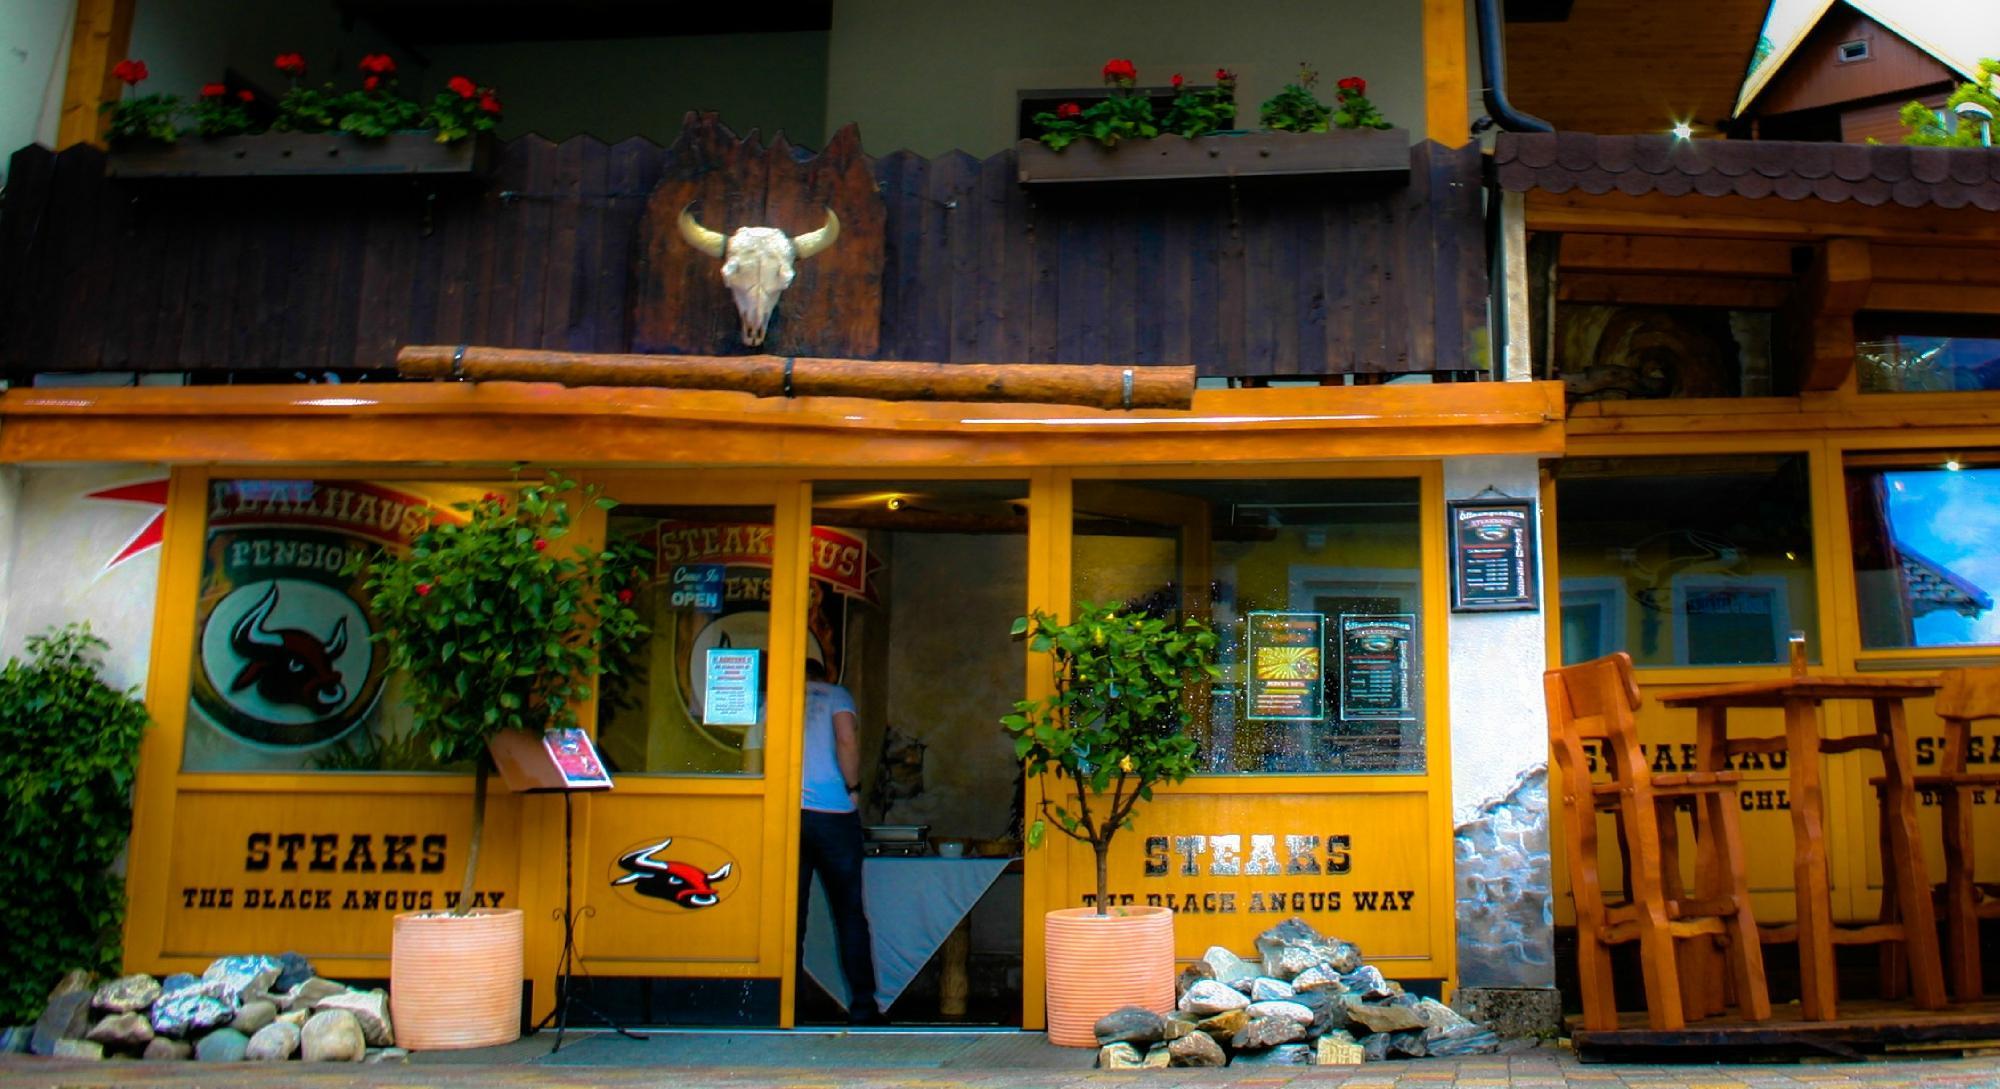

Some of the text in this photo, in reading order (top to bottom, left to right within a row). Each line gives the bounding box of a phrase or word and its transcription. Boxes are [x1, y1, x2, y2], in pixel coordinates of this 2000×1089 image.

[671, 591, 719, 608] OPEN
[245, 832, 448, 873] STEAKS
[1144, 834, 1352, 877] STEAKS
[182, 888, 233, 909] THE
[243, 889, 332, 910] BLACK
[342, 890, 433, 911] ANGUS
[1248, 892, 1342, 913] ANGUS
[1352, 890, 1415, 911] WAY
